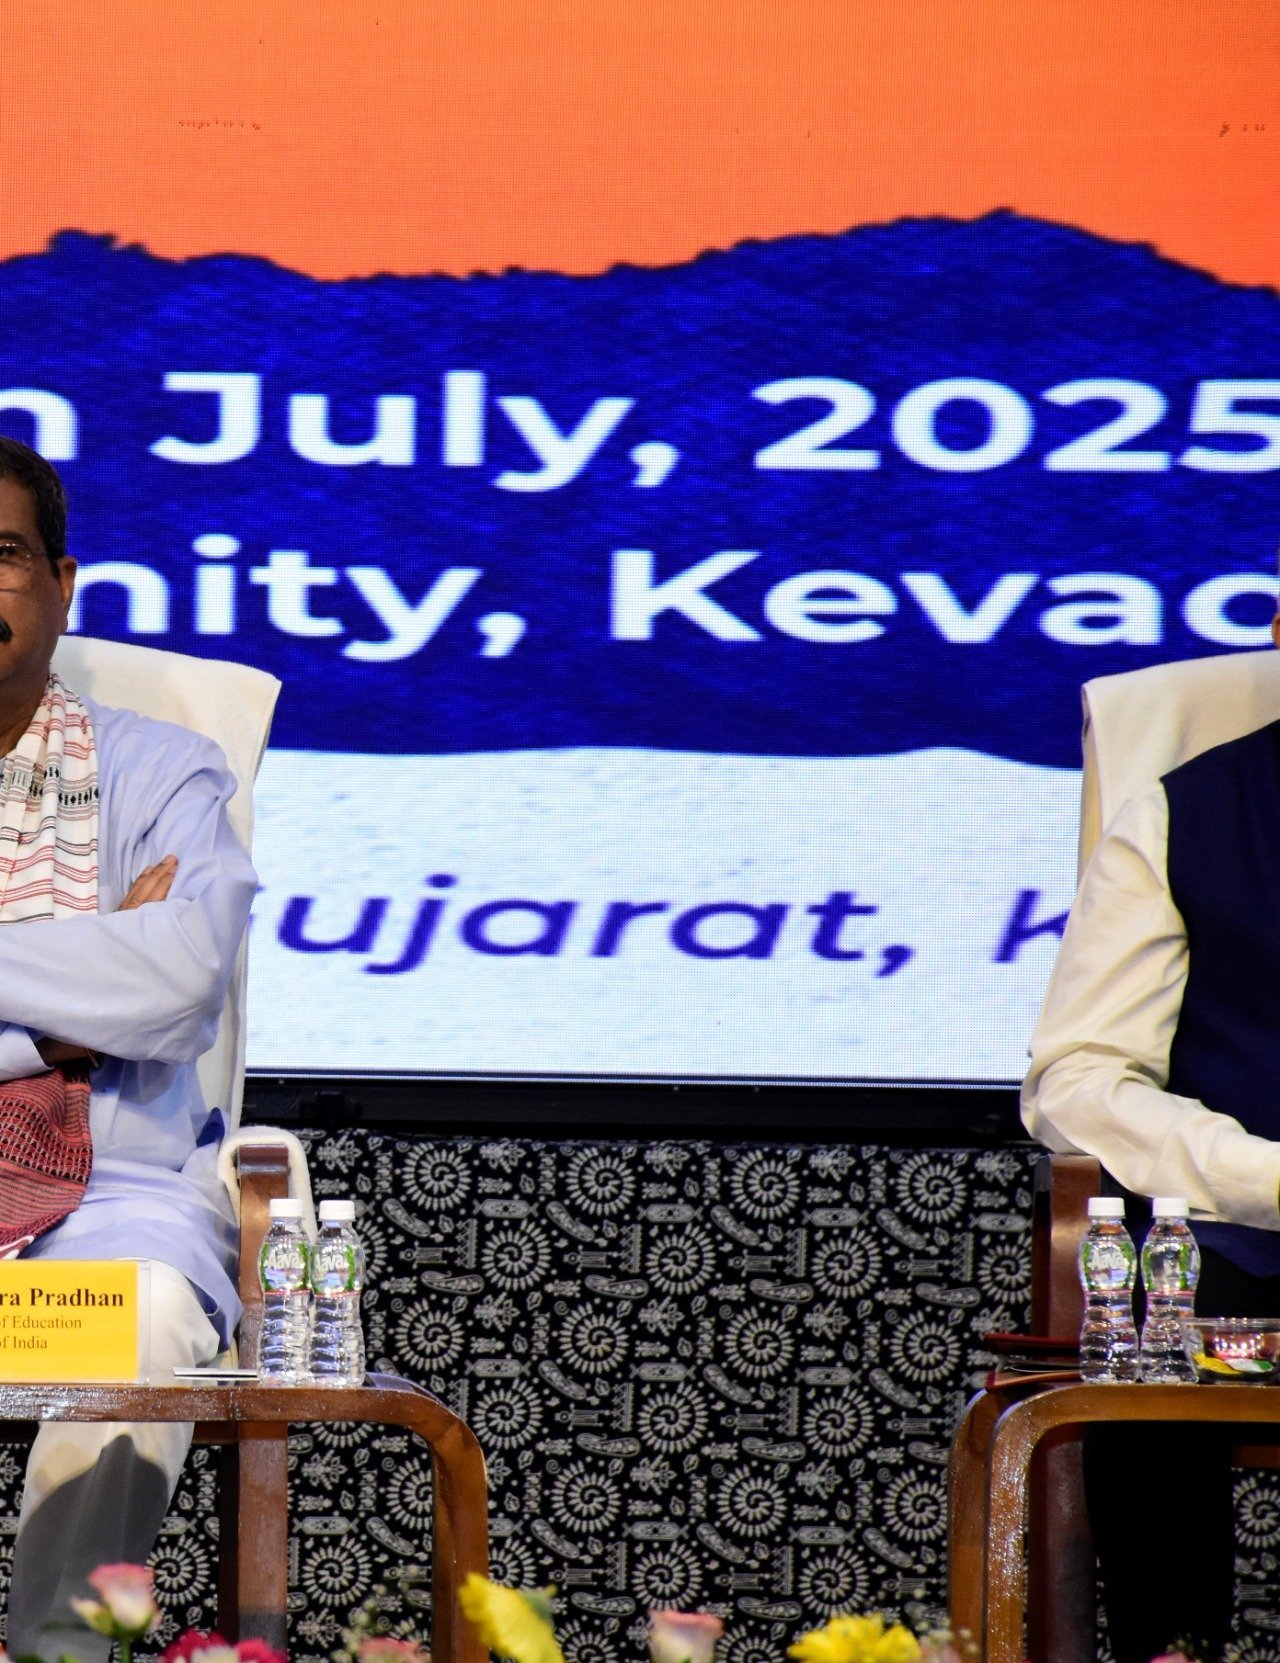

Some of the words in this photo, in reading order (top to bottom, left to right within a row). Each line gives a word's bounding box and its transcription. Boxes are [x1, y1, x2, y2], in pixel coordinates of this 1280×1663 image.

[150, 369, 680, 493] July,
[751, 376, 1280, 473] 2025
[250, 873, 915, 978] ujarat,
[30, 1287, 124, 1307] Pradhan
[12, 1315, 82, 1330] Education
[12, 1335, 48, 1349] India
